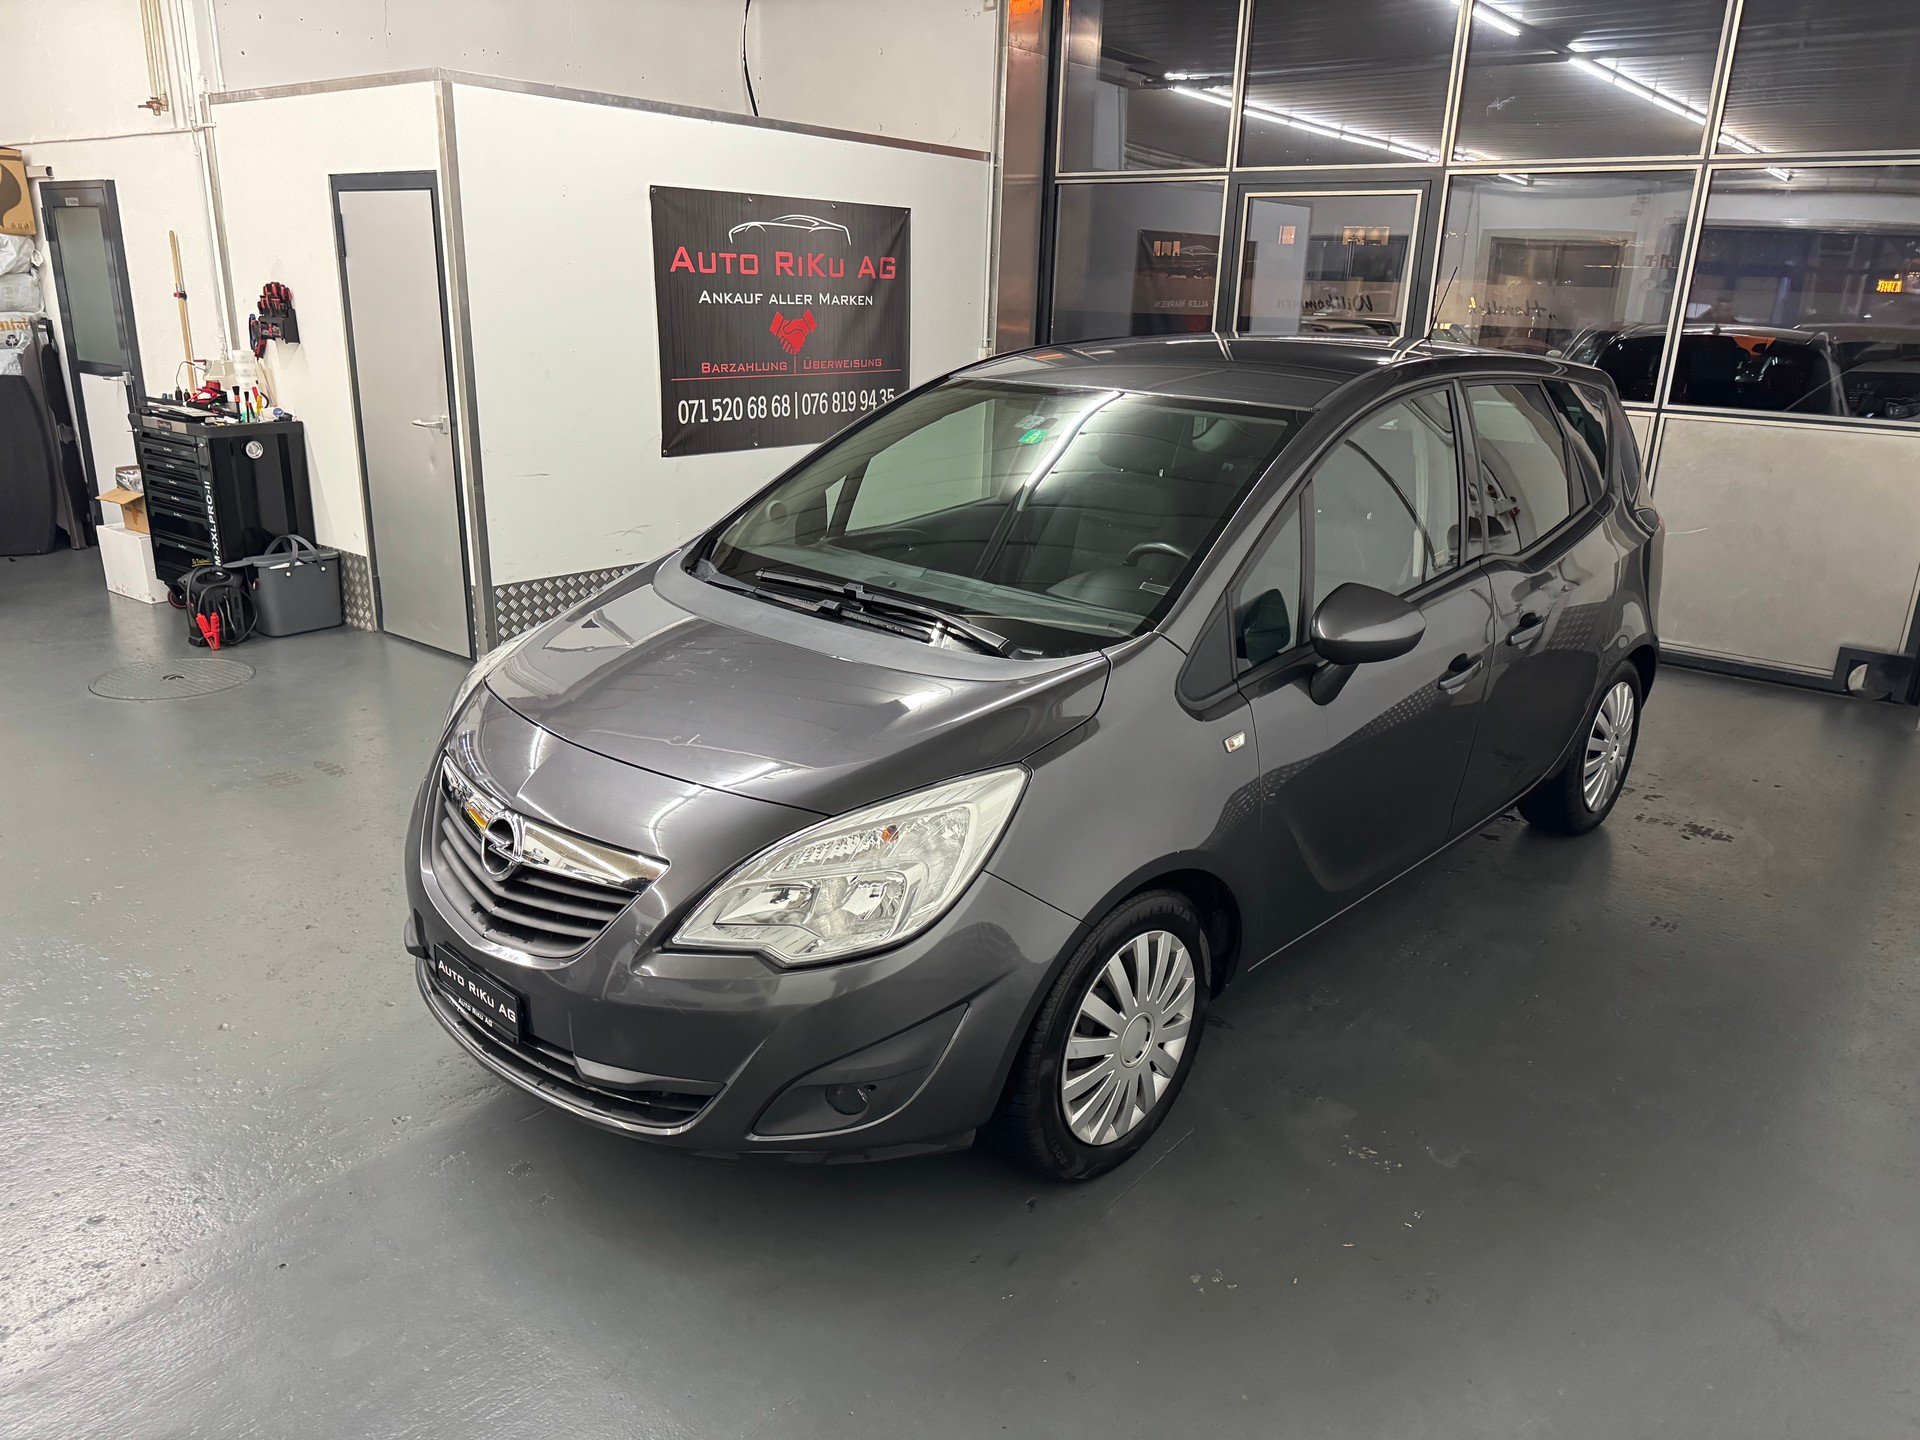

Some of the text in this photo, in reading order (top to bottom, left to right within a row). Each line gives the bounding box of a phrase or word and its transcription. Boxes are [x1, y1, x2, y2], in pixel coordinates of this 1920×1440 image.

[857, 255, 897, 280] AG
[699, 290, 874, 306] ANKAUF ALLER MARKEN
[701, 356, 883, 374] BARZAHLUNG ÜBERWEISUNG
[677, 399, 709, 425] 071
[712, 396, 743, 422] 520
[747, 395, 768, 420] 68
[771, 394, 791, 419] 68
[801, 392, 828, 416] 076
[831, 391, 856, 414] 819
[860, 389, 877, 411] 94
[439, 960, 464, 986] AUTO
[498, 1003, 516, 1024] AG
